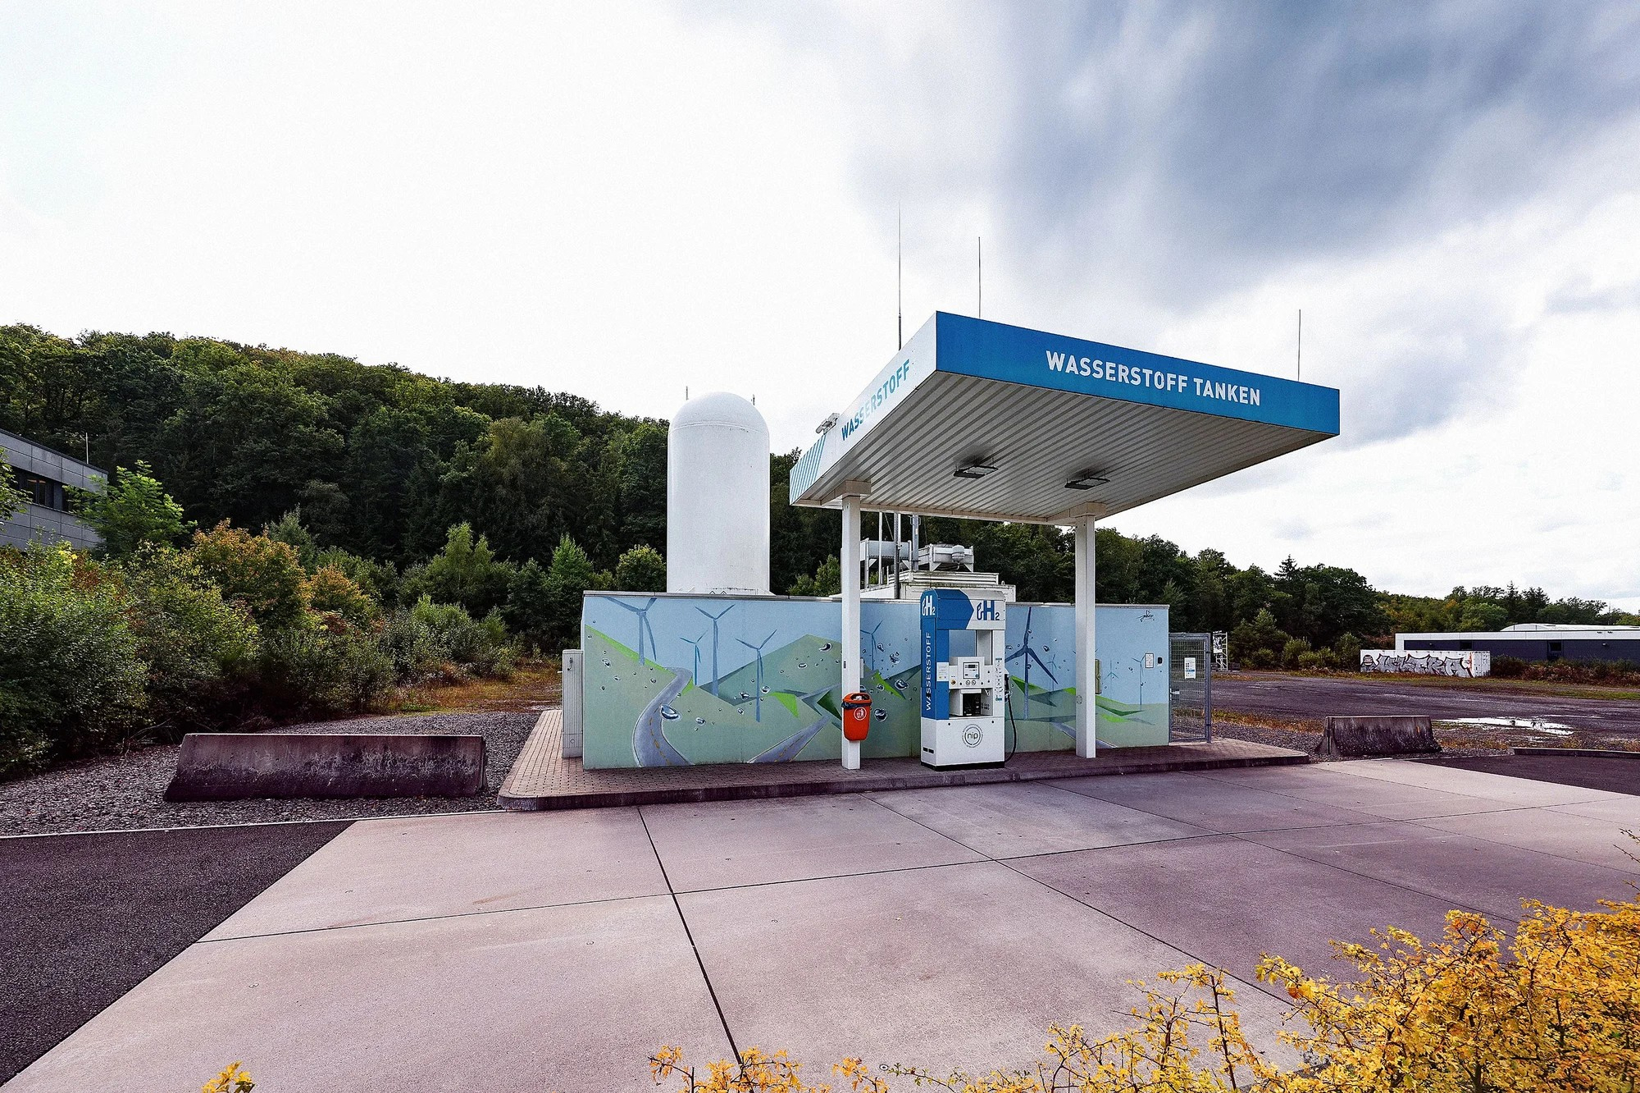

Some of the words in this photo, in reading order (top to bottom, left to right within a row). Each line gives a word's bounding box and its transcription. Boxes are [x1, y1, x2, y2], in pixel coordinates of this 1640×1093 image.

[841, 359, 910, 441] WASSERSTOFF
[1046, 350, 1188, 393] WASSERSTOFF
[1194, 378, 1261, 406] TANKEN
